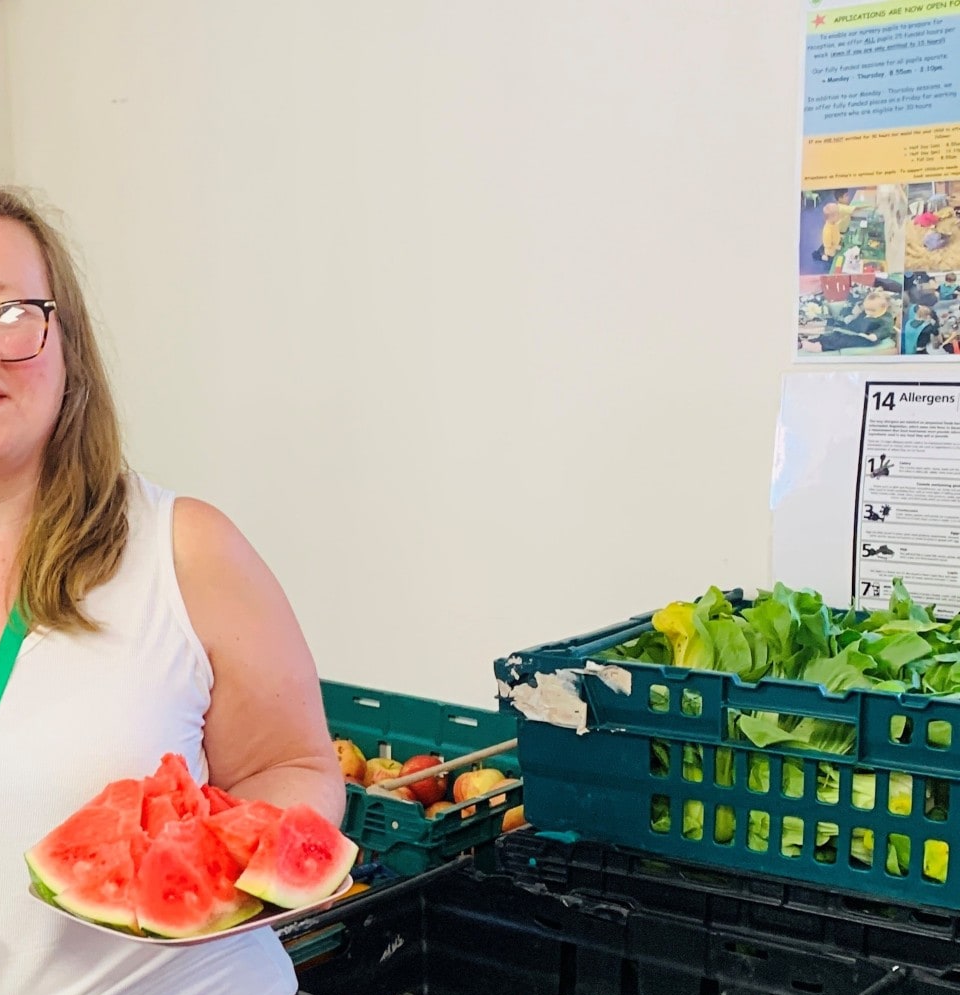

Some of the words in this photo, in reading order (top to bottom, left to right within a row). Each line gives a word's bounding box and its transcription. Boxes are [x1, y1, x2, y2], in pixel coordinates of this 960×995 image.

[834, 11, 886, 23] APPLICATIONS
[904, 5, 924, 13] NOW
[926, 2, 947, 11] OPEN
[872, 391, 896, 411] 14
[899, 392, 955, 405] Allergens
[861, 581, 871, 596] 7
